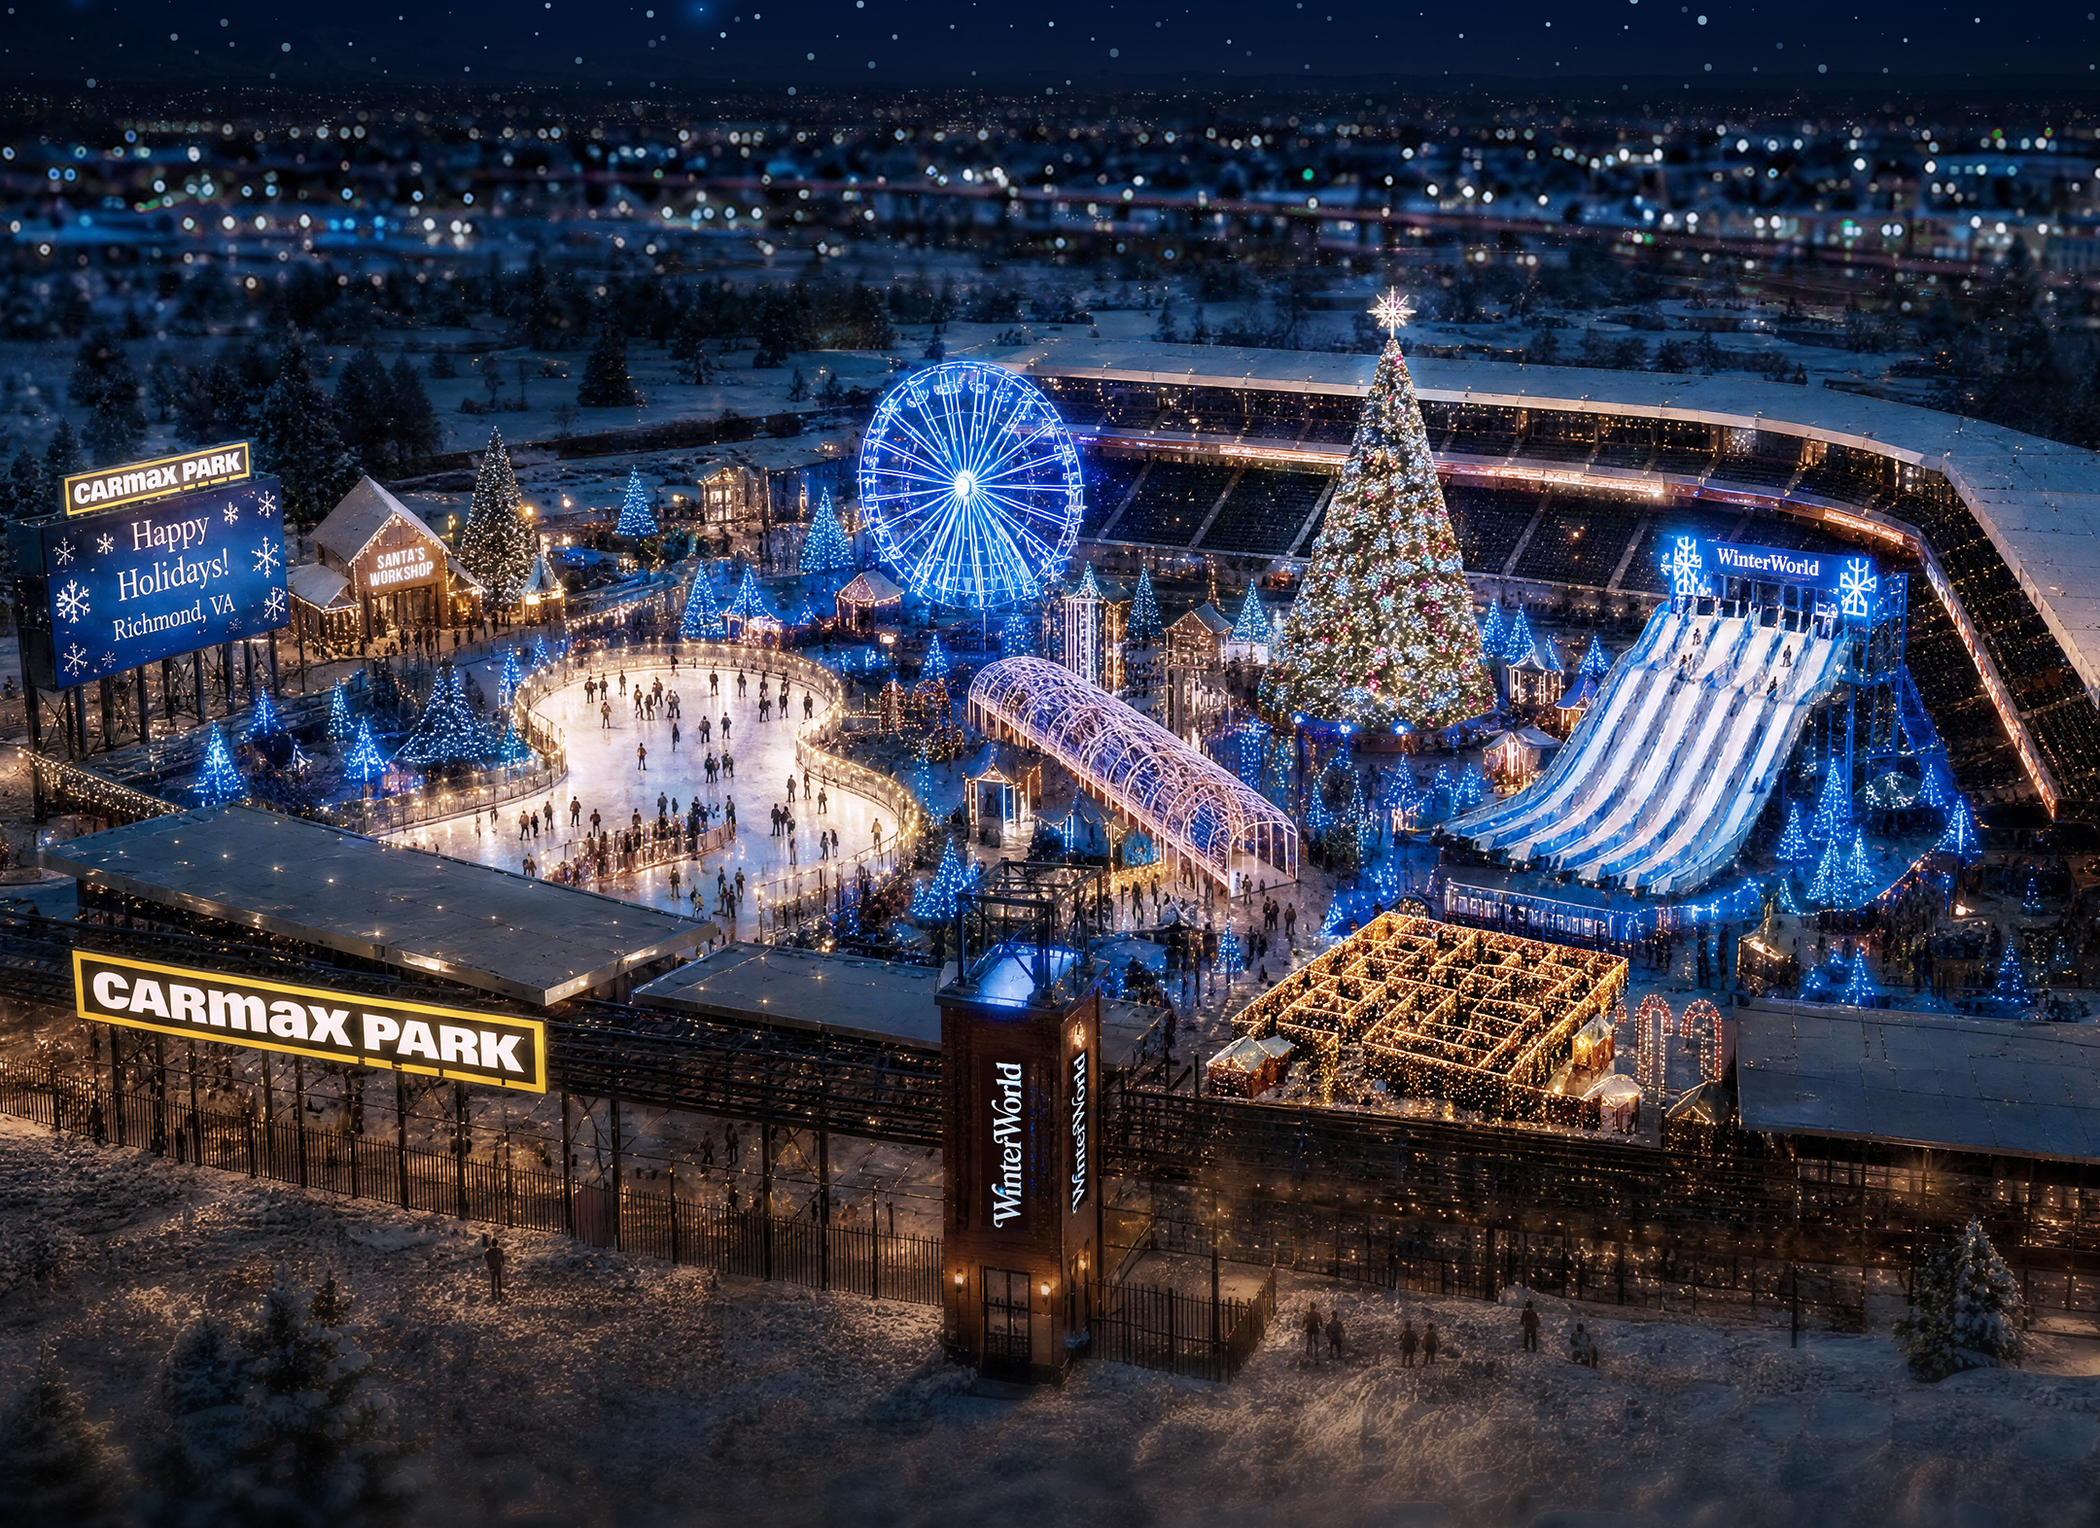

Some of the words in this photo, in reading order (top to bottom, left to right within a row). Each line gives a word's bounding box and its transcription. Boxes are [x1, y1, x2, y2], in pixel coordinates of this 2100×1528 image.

[73, 465, 178, 504] CARmax
[182, 451, 242, 482] PARK
[131, 516, 210, 553] Happy
[377, 547, 425, 570] SANTA'S
[117, 547, 230, 602] Holidays!
[369, 561, 434, 587] WORKSHOP
[1716, 547, 1820, 576] WinterWorld
[113, 599, 207, 642] Richmond,
[209, 593, 236, 616] VA
[92, 971, 354, 1048] CARmax
[363, 1013, 526, 1073] PARK
[991, 1061, 1023, 1229] WinterWorld
[1071, 1051, 1086, 1214] WinterWorld
